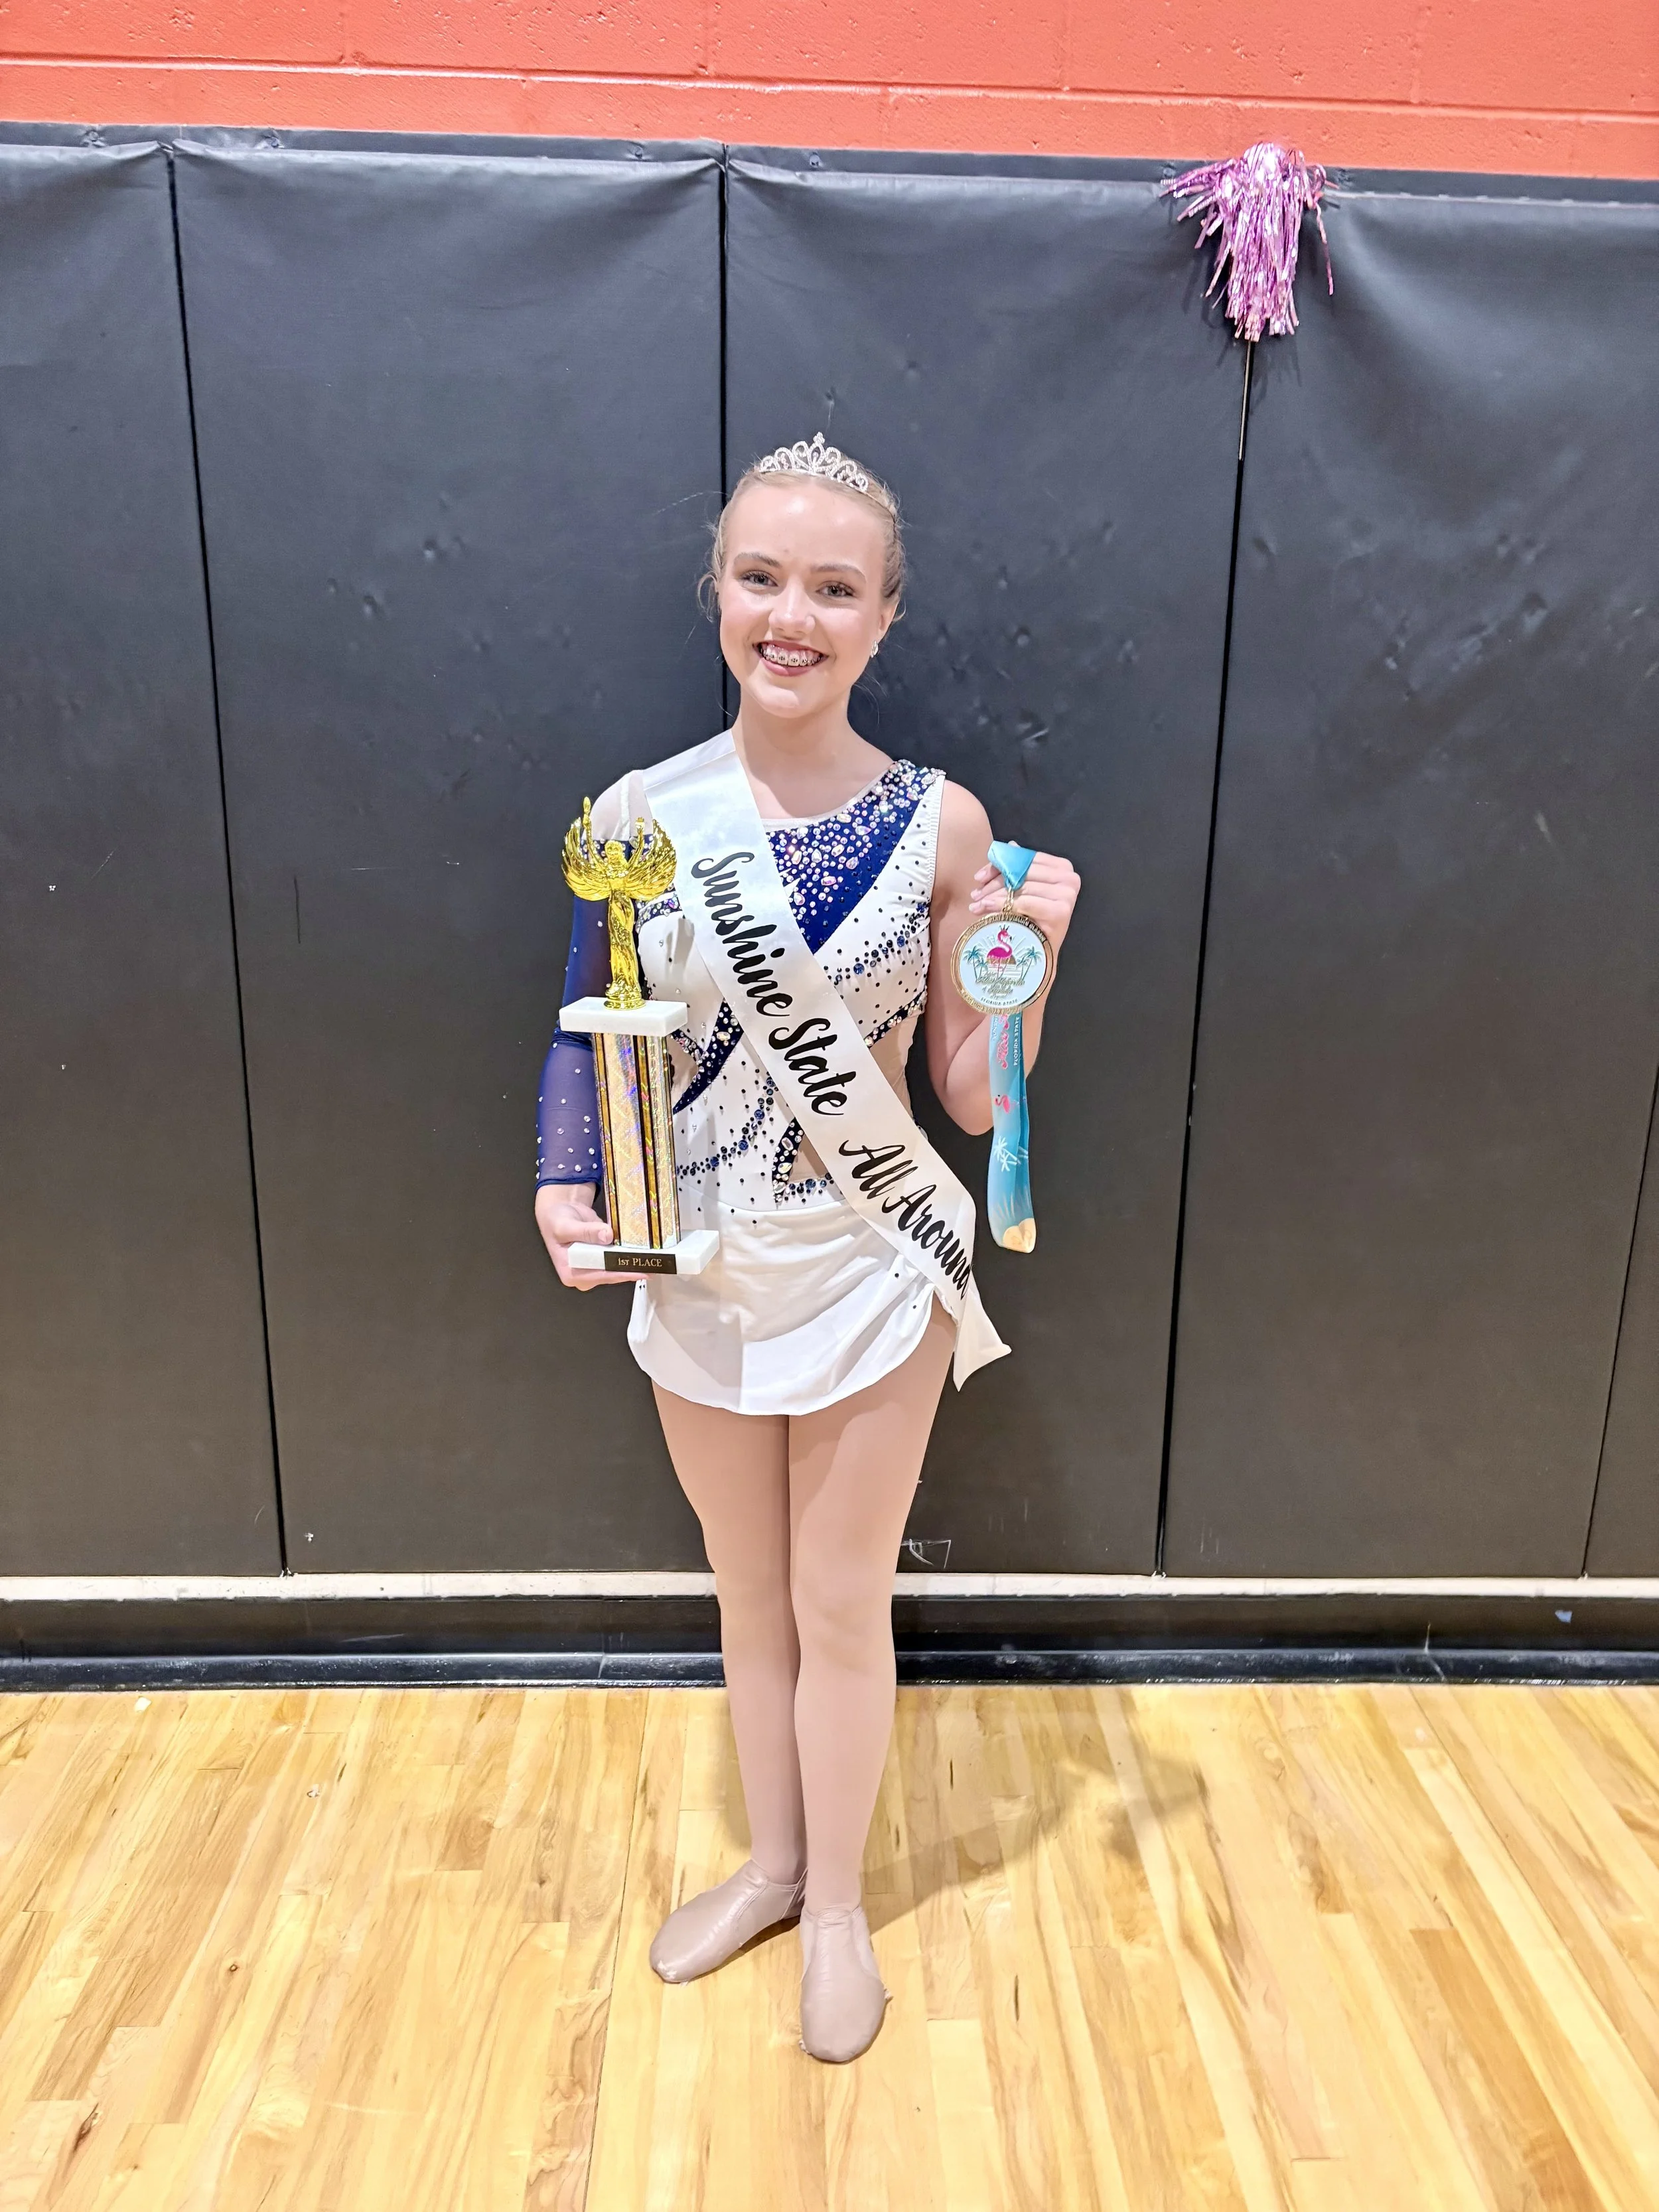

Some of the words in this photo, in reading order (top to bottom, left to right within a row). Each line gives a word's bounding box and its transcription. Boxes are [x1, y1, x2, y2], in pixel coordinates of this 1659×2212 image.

[691, 851, 793, 1017] Sunshine
[768, 1017, 857, 1116] State
[838, 1140, 918, 1200] All
[632, 1258, 662, 1267] PLACE
